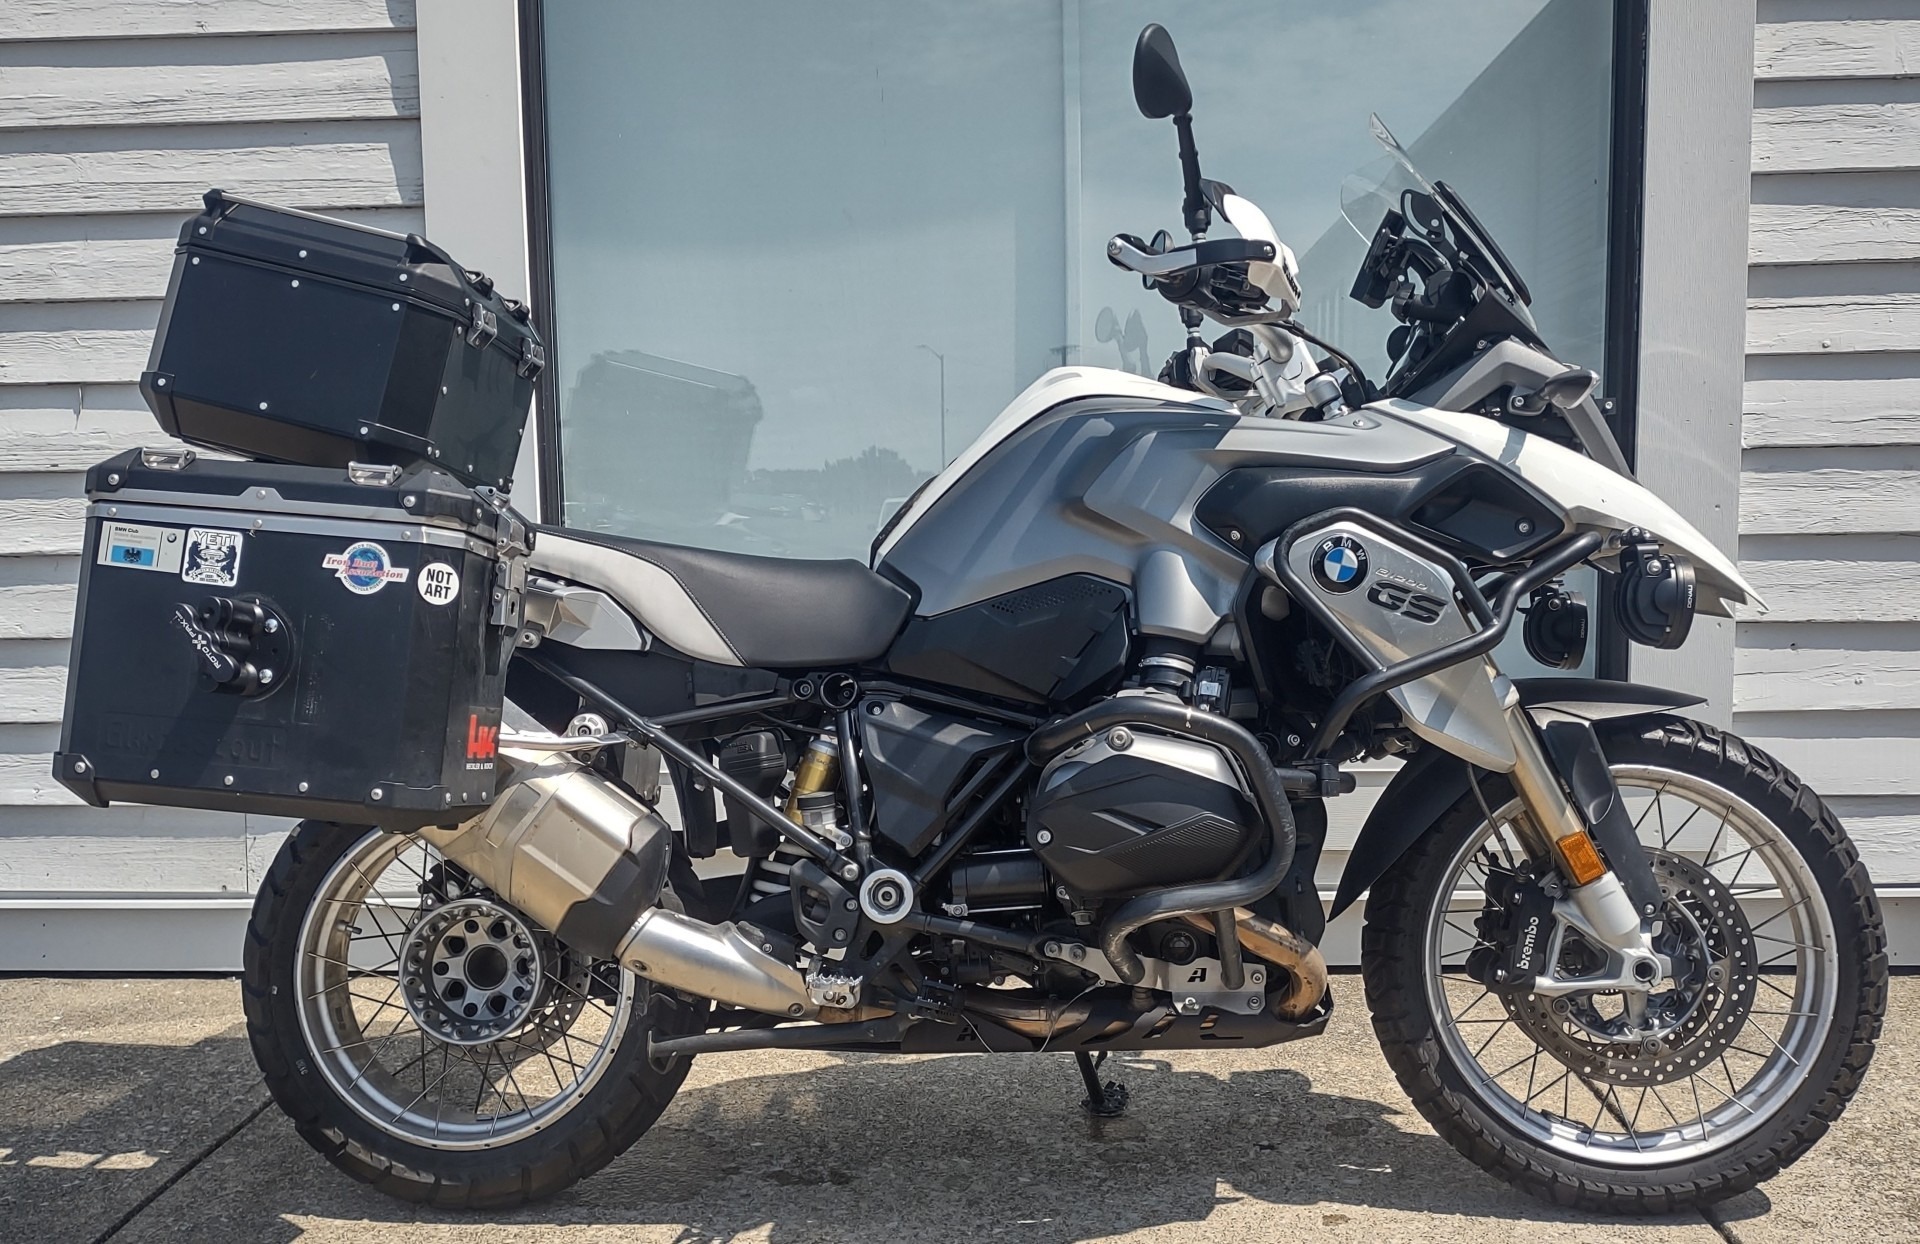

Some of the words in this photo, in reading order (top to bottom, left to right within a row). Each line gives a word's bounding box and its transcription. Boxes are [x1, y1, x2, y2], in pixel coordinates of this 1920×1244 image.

[193, 530, 236, 547] YETI
[1322, 536, 1367, 561] BMW
[326, 556, 350, 566] Iron
[426, 568, 453, 585] NOT
[424, 583, 451, 599] ART
[1367, 581, 1448, 624] GS
[201, 646, 222, 669] ROTO
[1516, 916, 1539, 969] brembo
